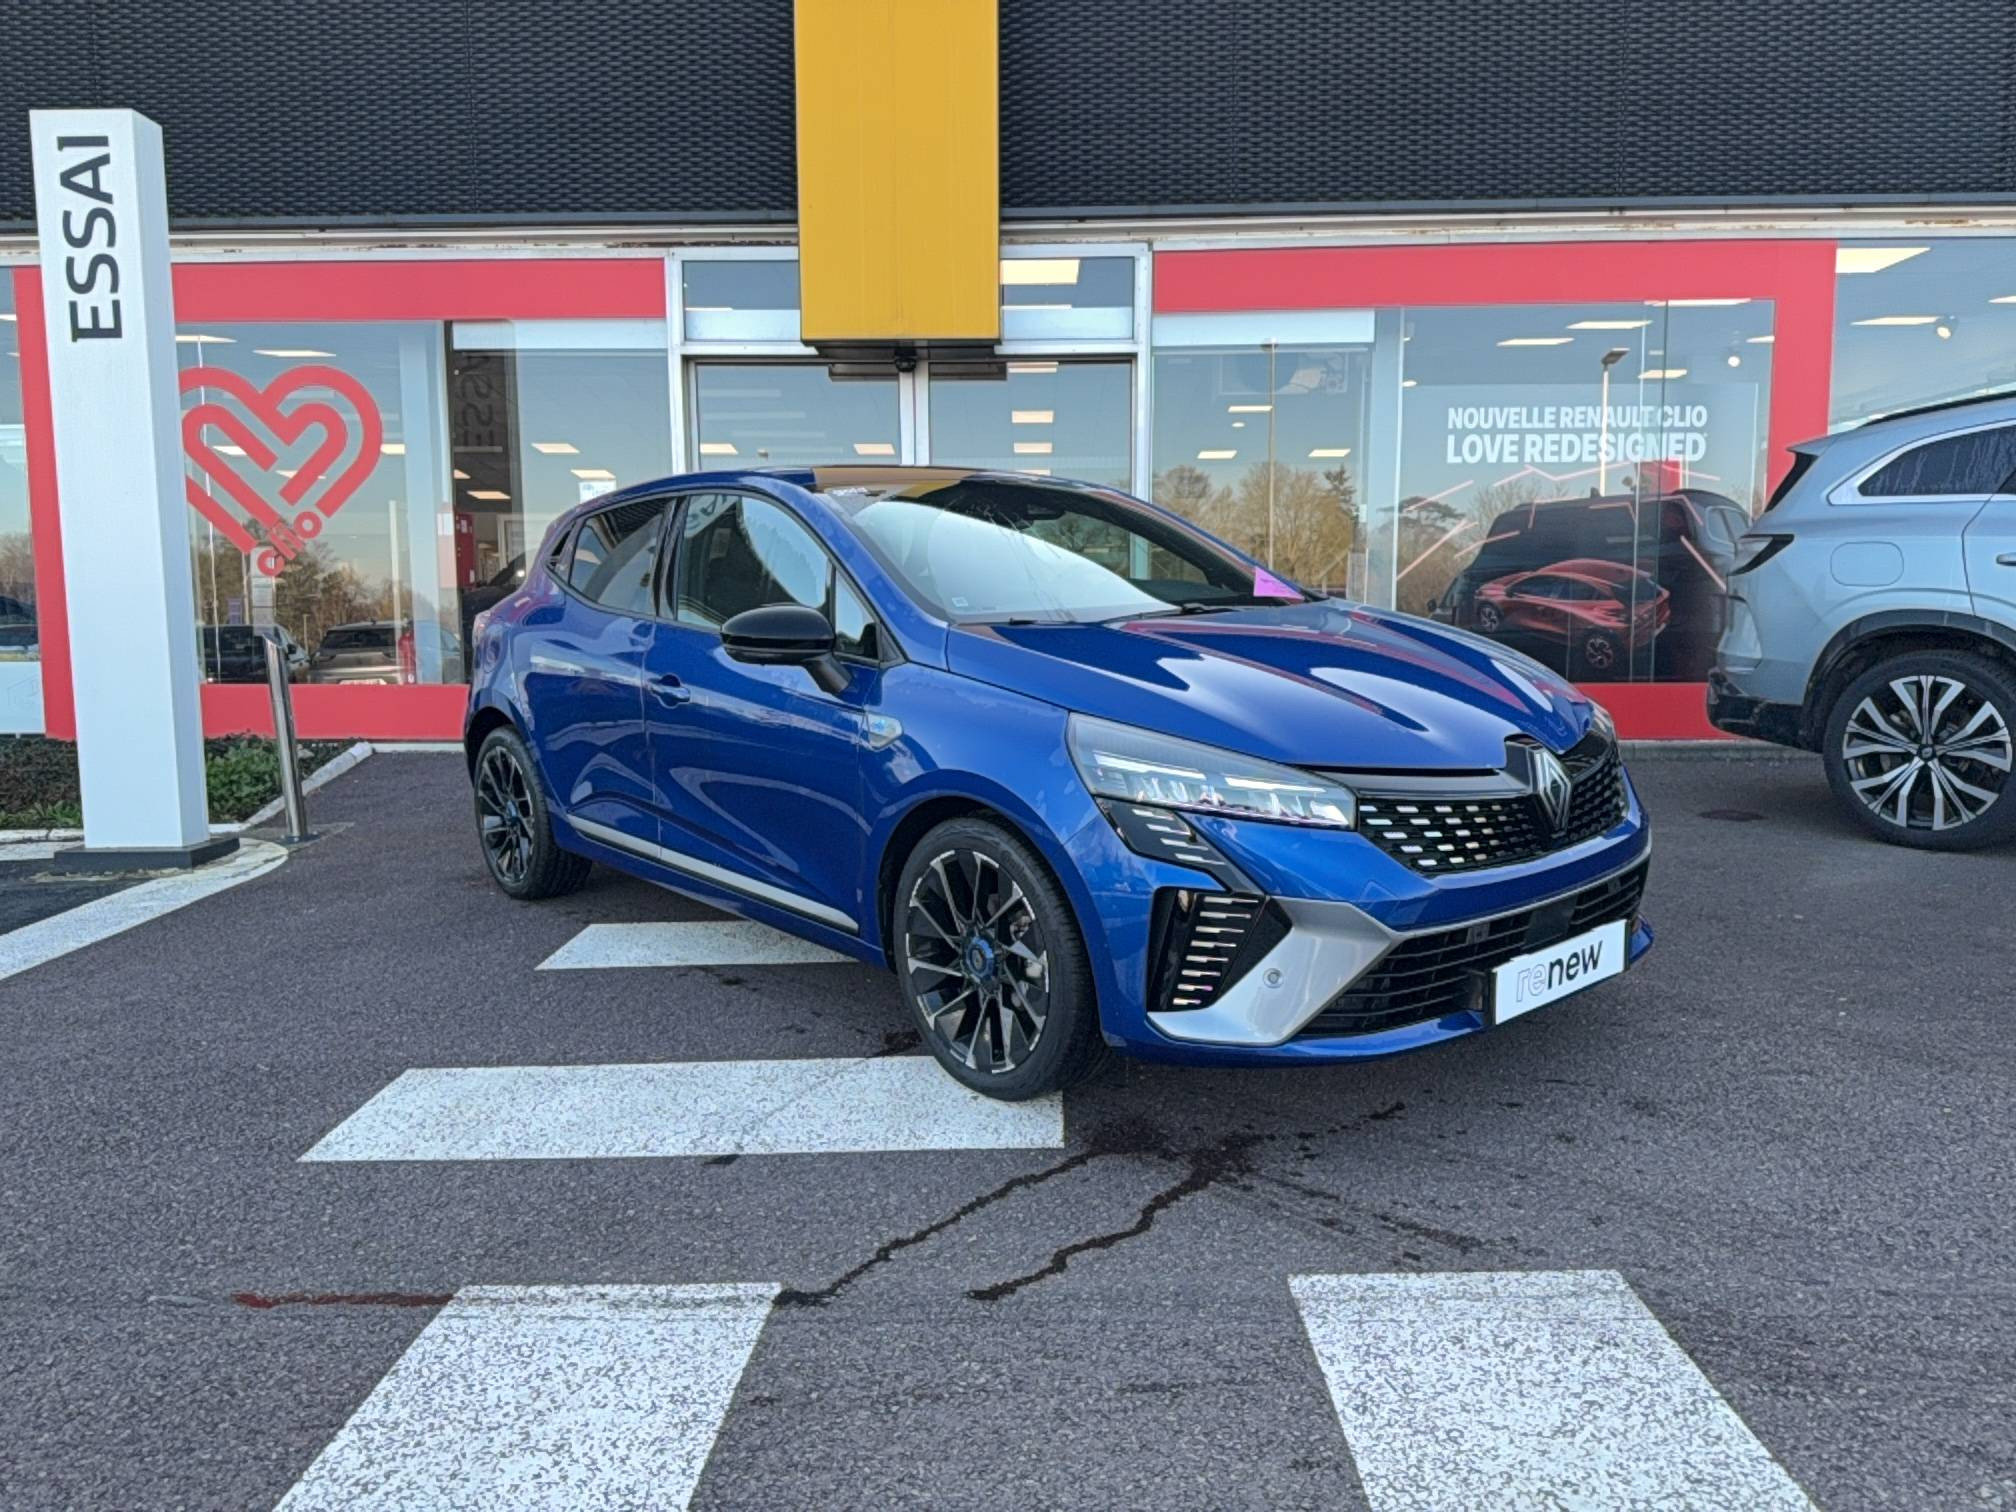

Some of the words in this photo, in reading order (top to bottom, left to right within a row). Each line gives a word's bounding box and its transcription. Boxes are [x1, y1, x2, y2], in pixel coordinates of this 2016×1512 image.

[56, 135, 123, 343] ESSAI
[1447, 406, 1557, 429] NOUVELLE
[1559, 405, 1655, 428] RENAULT
[1657, 405, 1708, 428] CLIO
[1446, 434, 1519, 464] LOVE
[1515, 939, 1604, 1003] renew
